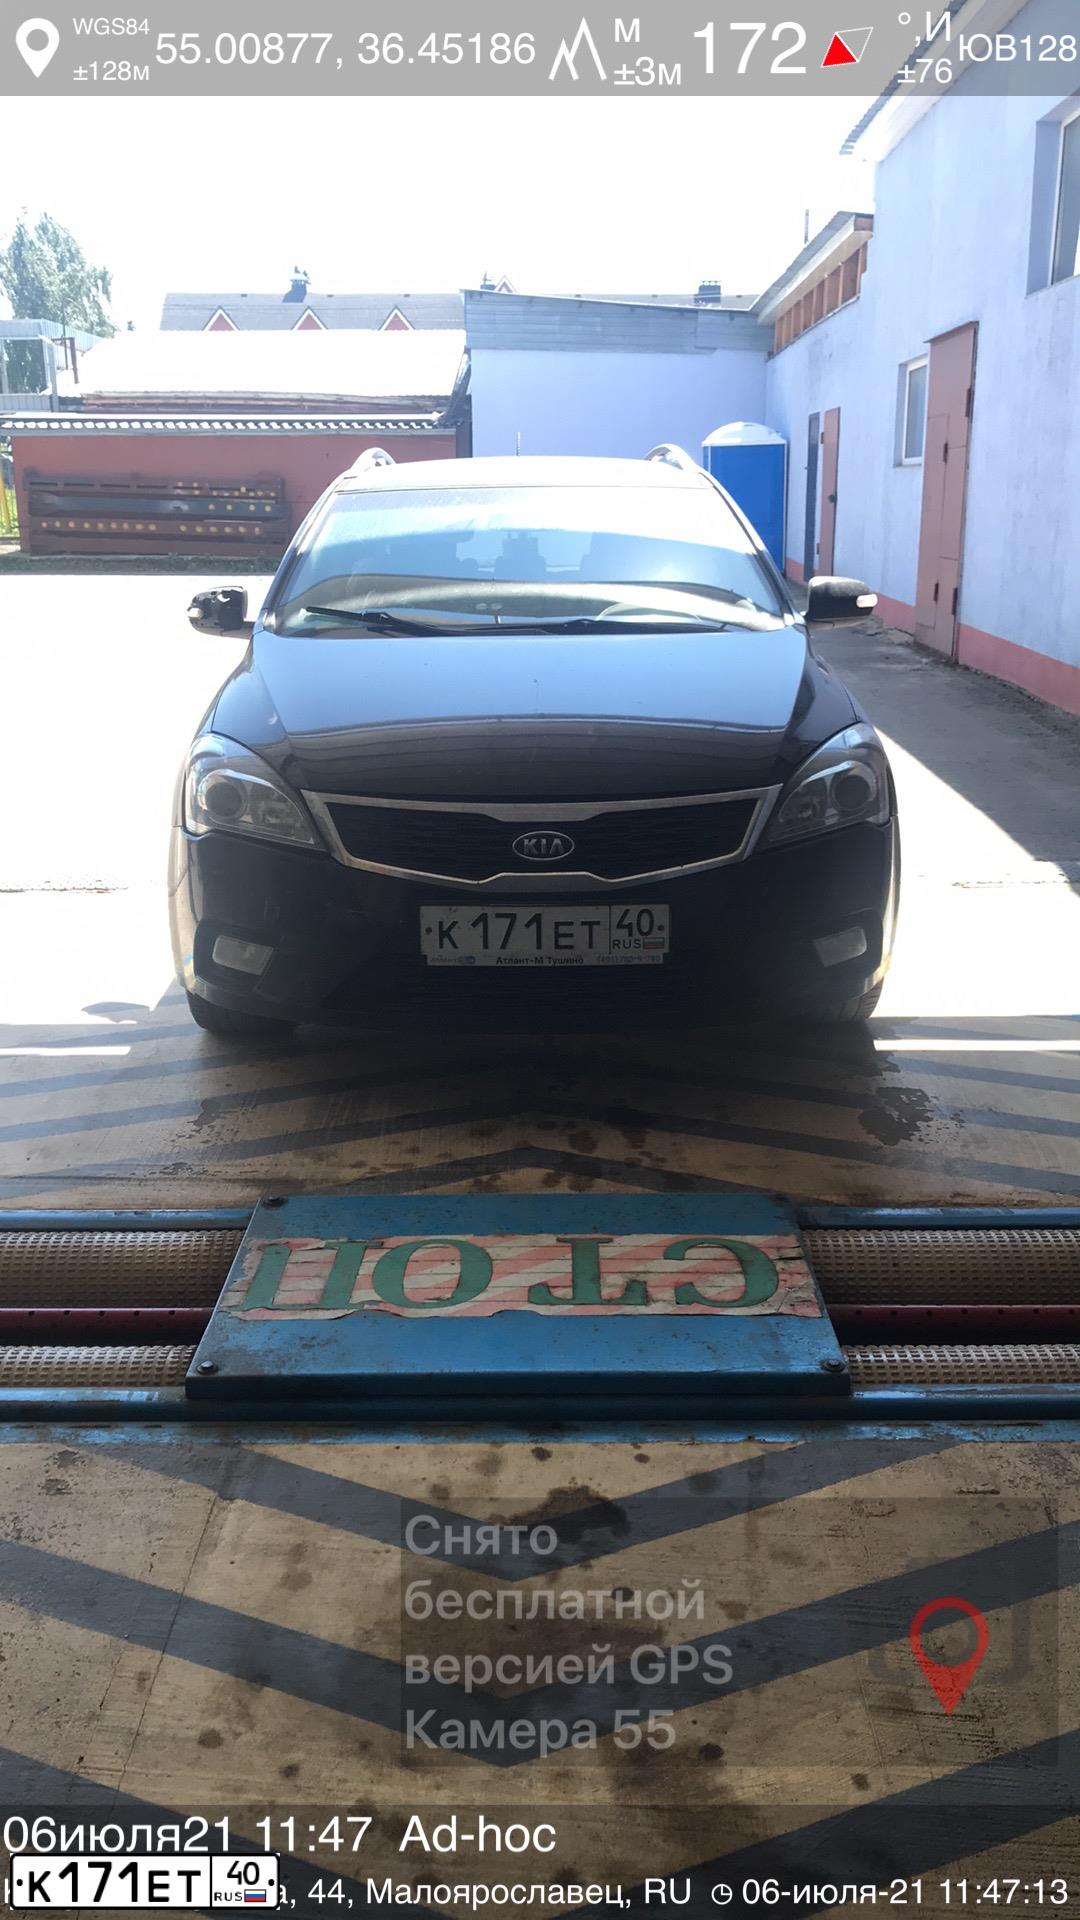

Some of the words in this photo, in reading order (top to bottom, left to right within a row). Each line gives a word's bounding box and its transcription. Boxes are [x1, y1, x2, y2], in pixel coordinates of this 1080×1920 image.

[524, 838, 565, 854] KIA
[615, 908, 655, 937] 40
[612, 938, 642, 949] RUS
[495, 955, 544, 965] Атлант-М
[224, 1236, 781, 1310] СТОП
